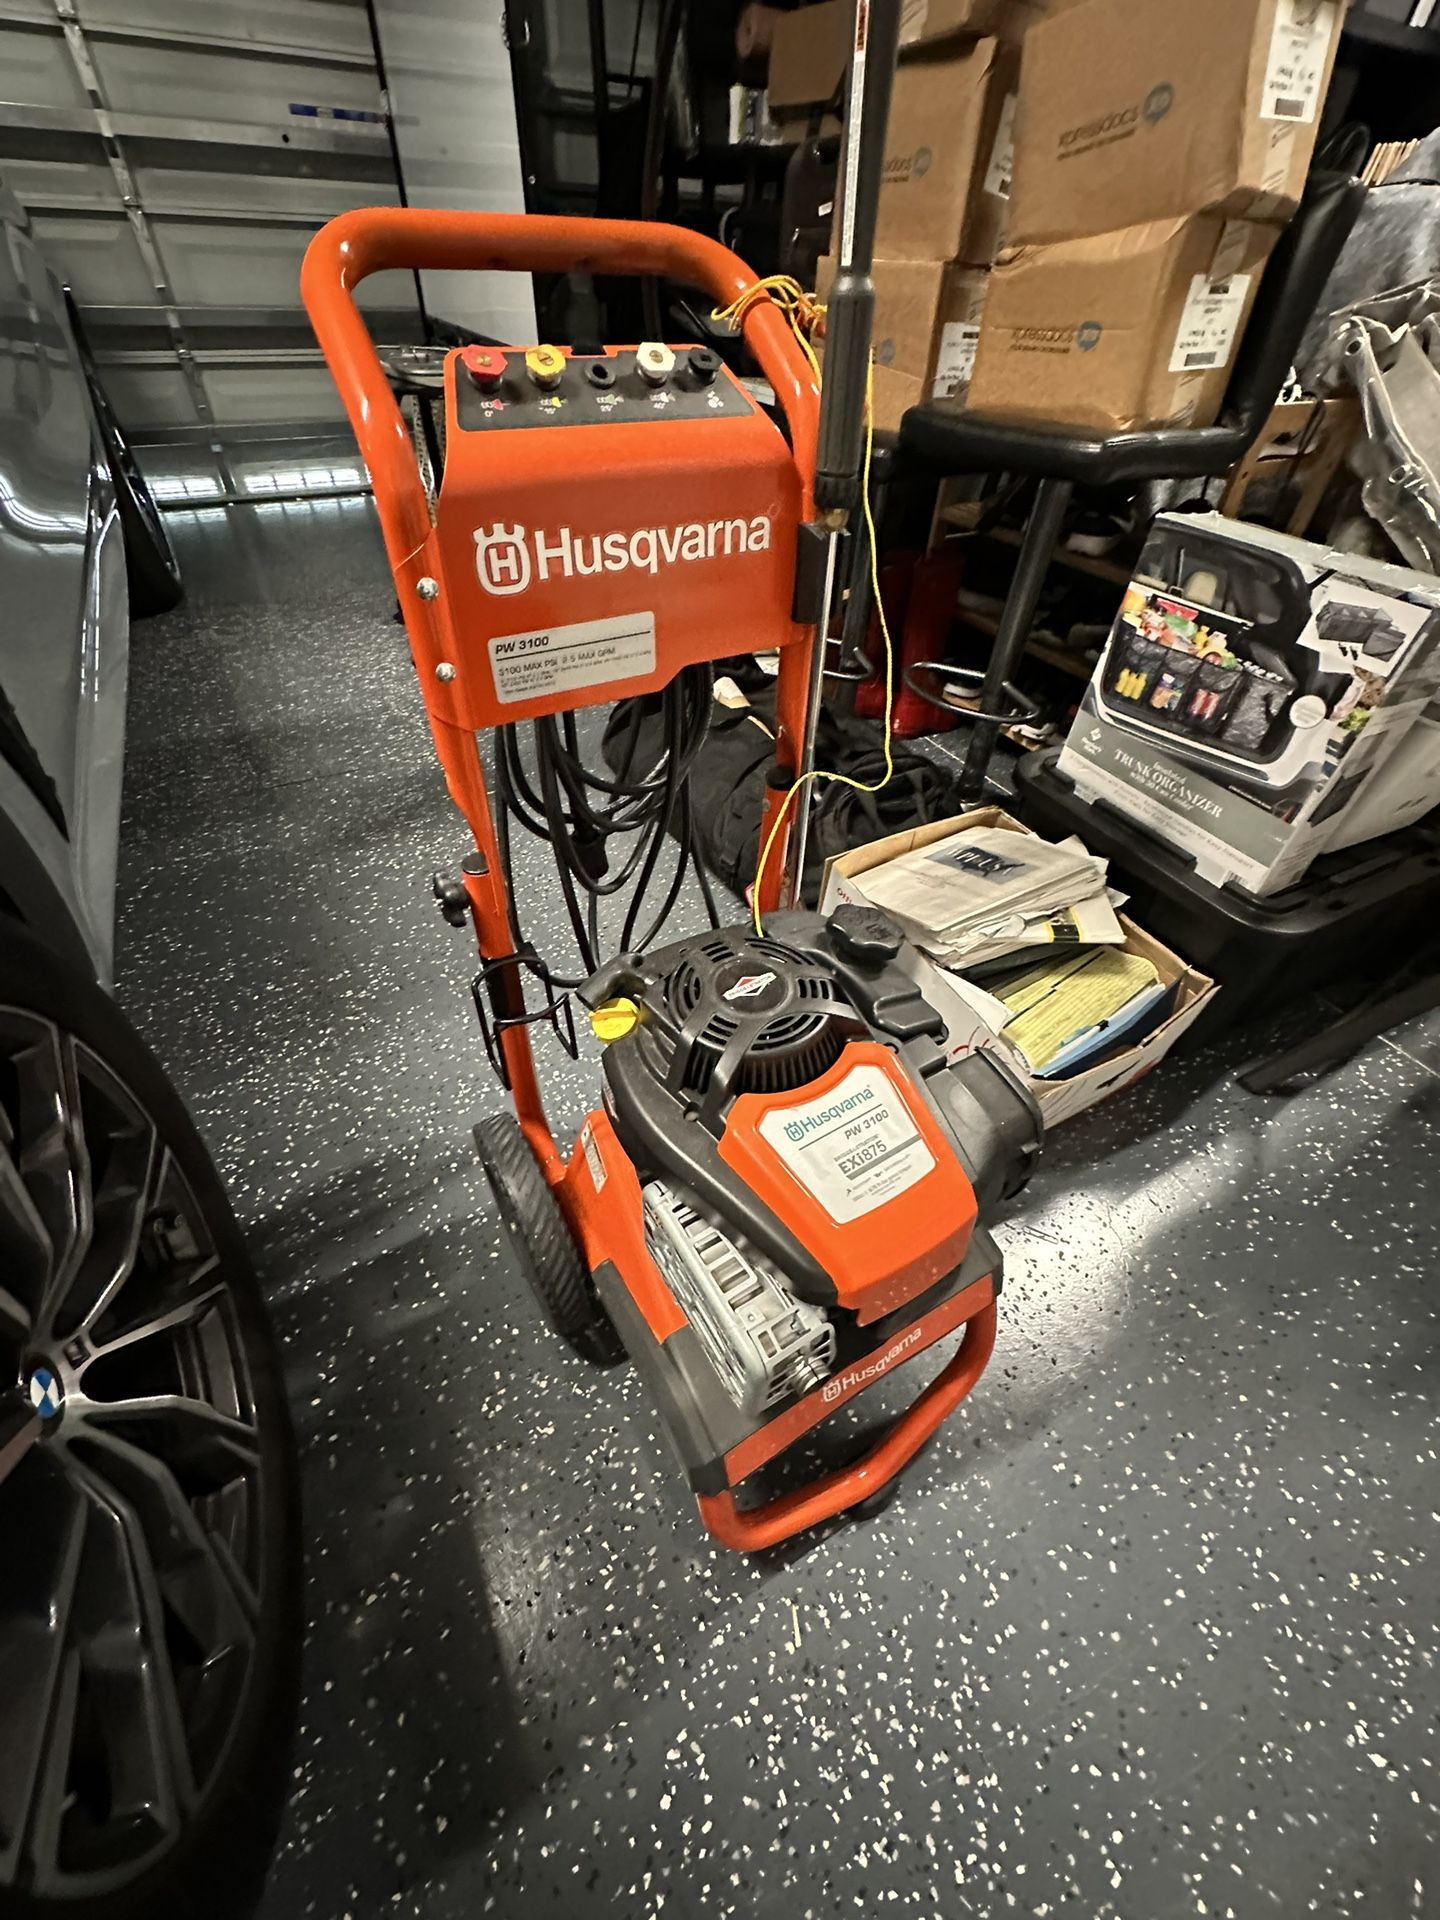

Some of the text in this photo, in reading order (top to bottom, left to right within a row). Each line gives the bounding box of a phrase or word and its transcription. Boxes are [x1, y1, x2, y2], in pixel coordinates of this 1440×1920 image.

[534, 515, 771, 580] Husqvarna
[495, 636, 550, 655] PW 3100
[498, 665, 521, 677] 3100
[523, 662, 543, 672] MAX
[577, 652, 596, 661] MAX
[597, 647, 616, 658] GPM
[1114, 748, 1151, 778] TRUNK
[1152, 771, 1224, 818] ORGANIZER
[800, 1086, 875, 1133] Husqvarna
[844, 1109, 890, 1140] PW 3100
[838, 1140, 887, 1174] EXi875
[842, 1327, 922, 1390] Husqvarna
